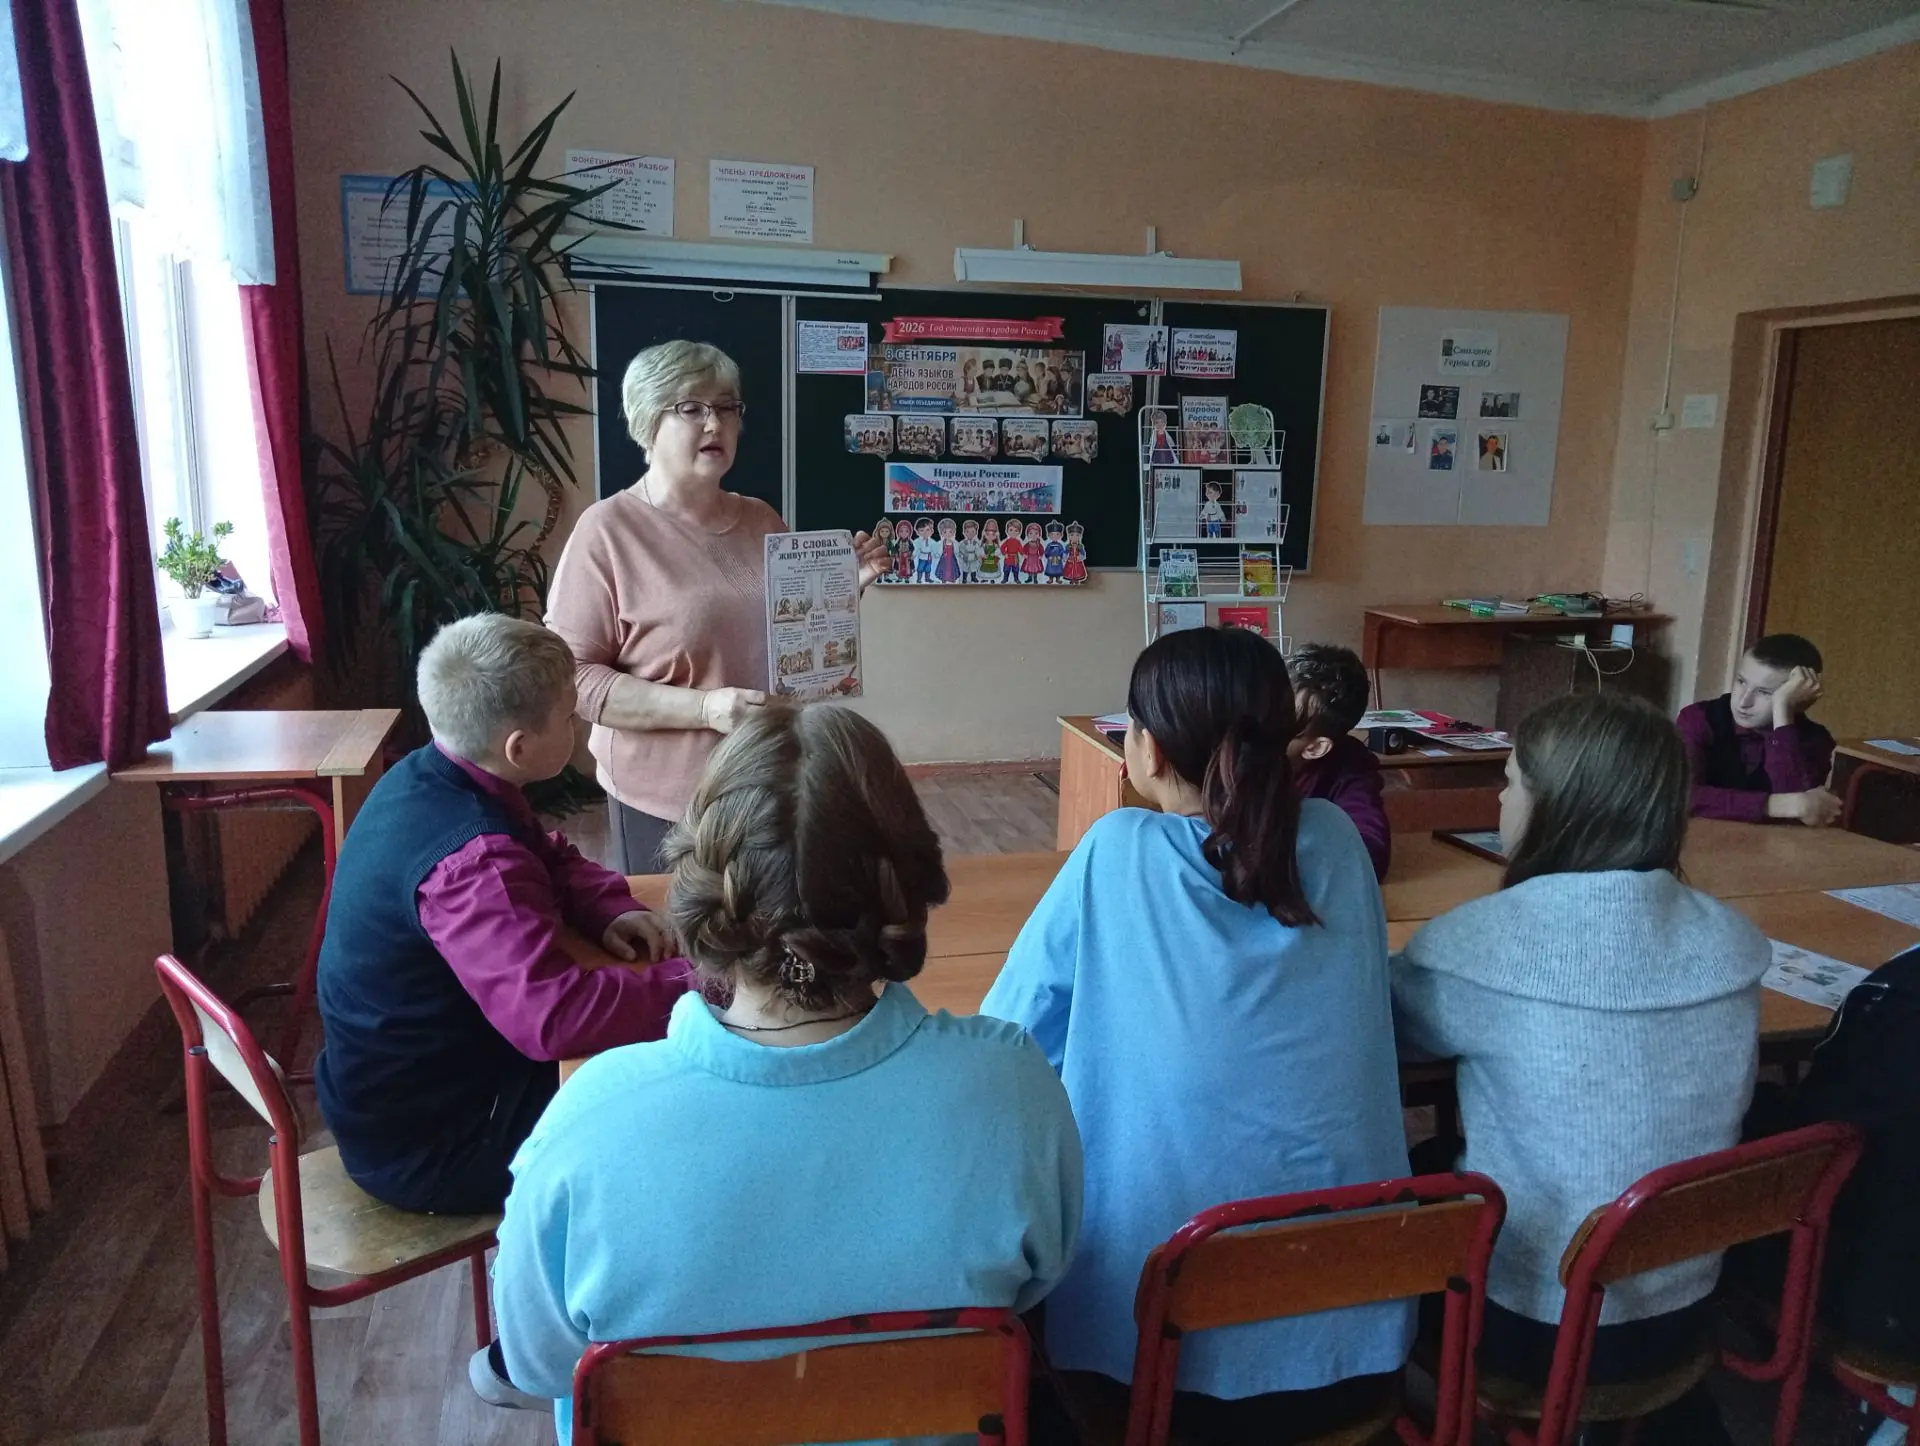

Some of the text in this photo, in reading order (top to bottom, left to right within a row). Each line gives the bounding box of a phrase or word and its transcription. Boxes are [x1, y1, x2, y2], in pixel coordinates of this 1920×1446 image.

[607, 168, 634, 176] СЛОВА
[638, 163, 669, 173] РАЗБОР
[718, 167, 746, 176] ЧЛЕНЫ
[749, 169, 807, 181] ПРЕДЛОЖЕНИЯ
[899, 321, 925, 336] 2026
[929, 324, 945, 338] Год
[985, 329, 1018, 340] народов
[1020, 328, 1049, 339] России
[886, 349, 957, 362] 8 СЕНТЯБРЯ
[1471, 359, 1491, 368] СВО
[891, 367, 954, 379] ДЕНЬ ЯЗЫКОВ
[887, 379, 957, 392] НАРОДОВ РОССИИ
[1187, 414, 1219, 422] России
[933, 468, 976, 482] Народы
[942, 480, 986, 493] дружбы
[988, 482, 996, 490] в
[792, 538, 838, 550] В словах
[778, 547, 851, 561] живут традиции
